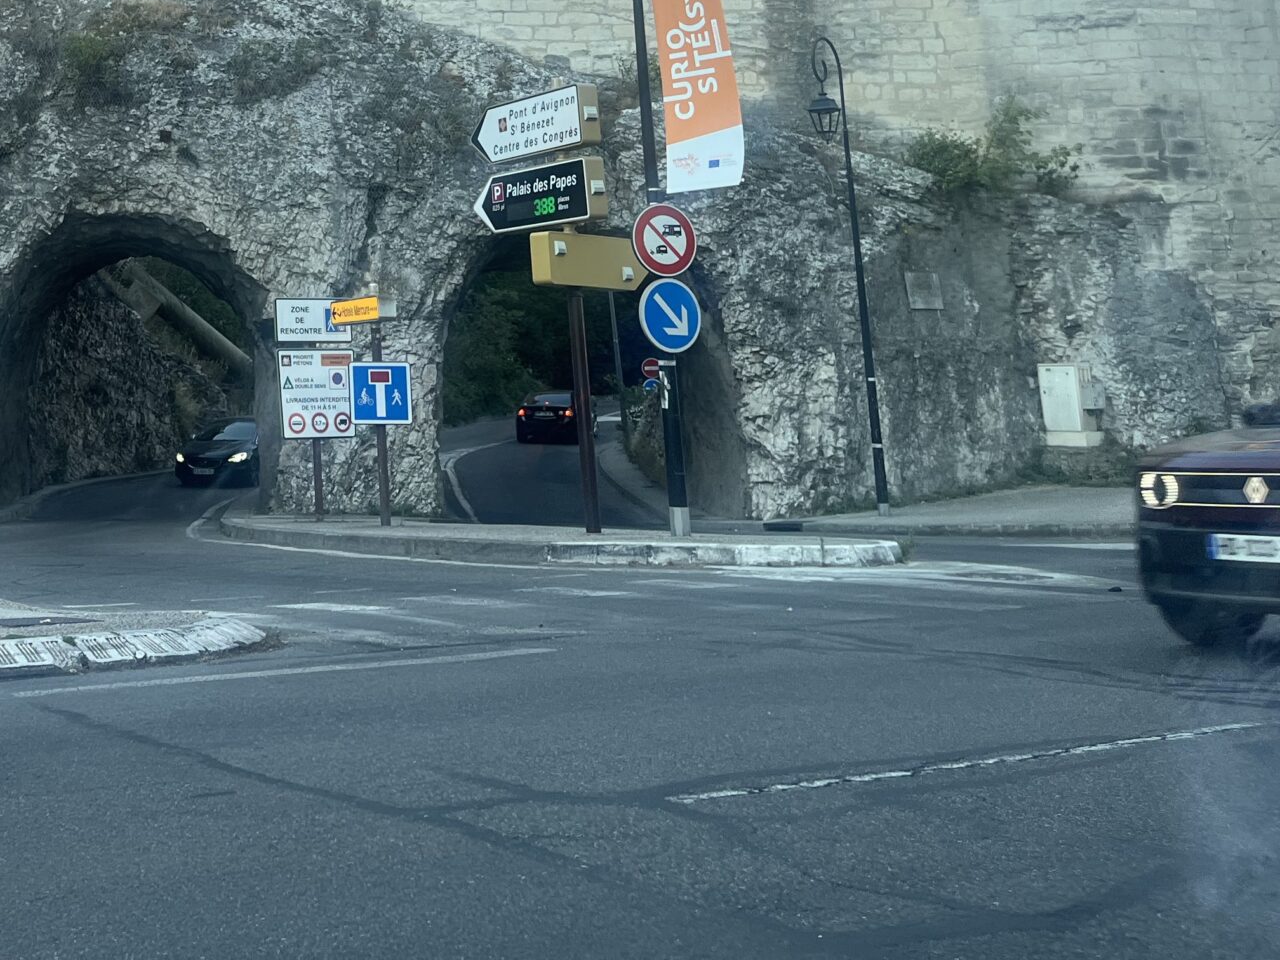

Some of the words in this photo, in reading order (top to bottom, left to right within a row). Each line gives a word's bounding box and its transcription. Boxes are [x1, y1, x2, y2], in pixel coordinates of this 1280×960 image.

[665, 28, 696, 121] CURIO
[509, 107, 527, 120] Pont
[532, 95, 575, 115] d'Avignon
[520, 116, 554, 134] Bénezet
[493, 141, 520, 156] Centre
[524, 136, 538, 148] des
[542, 126, 578, 145] Congrès
[506, 180, 531, 198] Palais
[533, 178, 548, 194] des
[550, 174, 577, 192] Papes
[533, 196, 556, 216] 388
